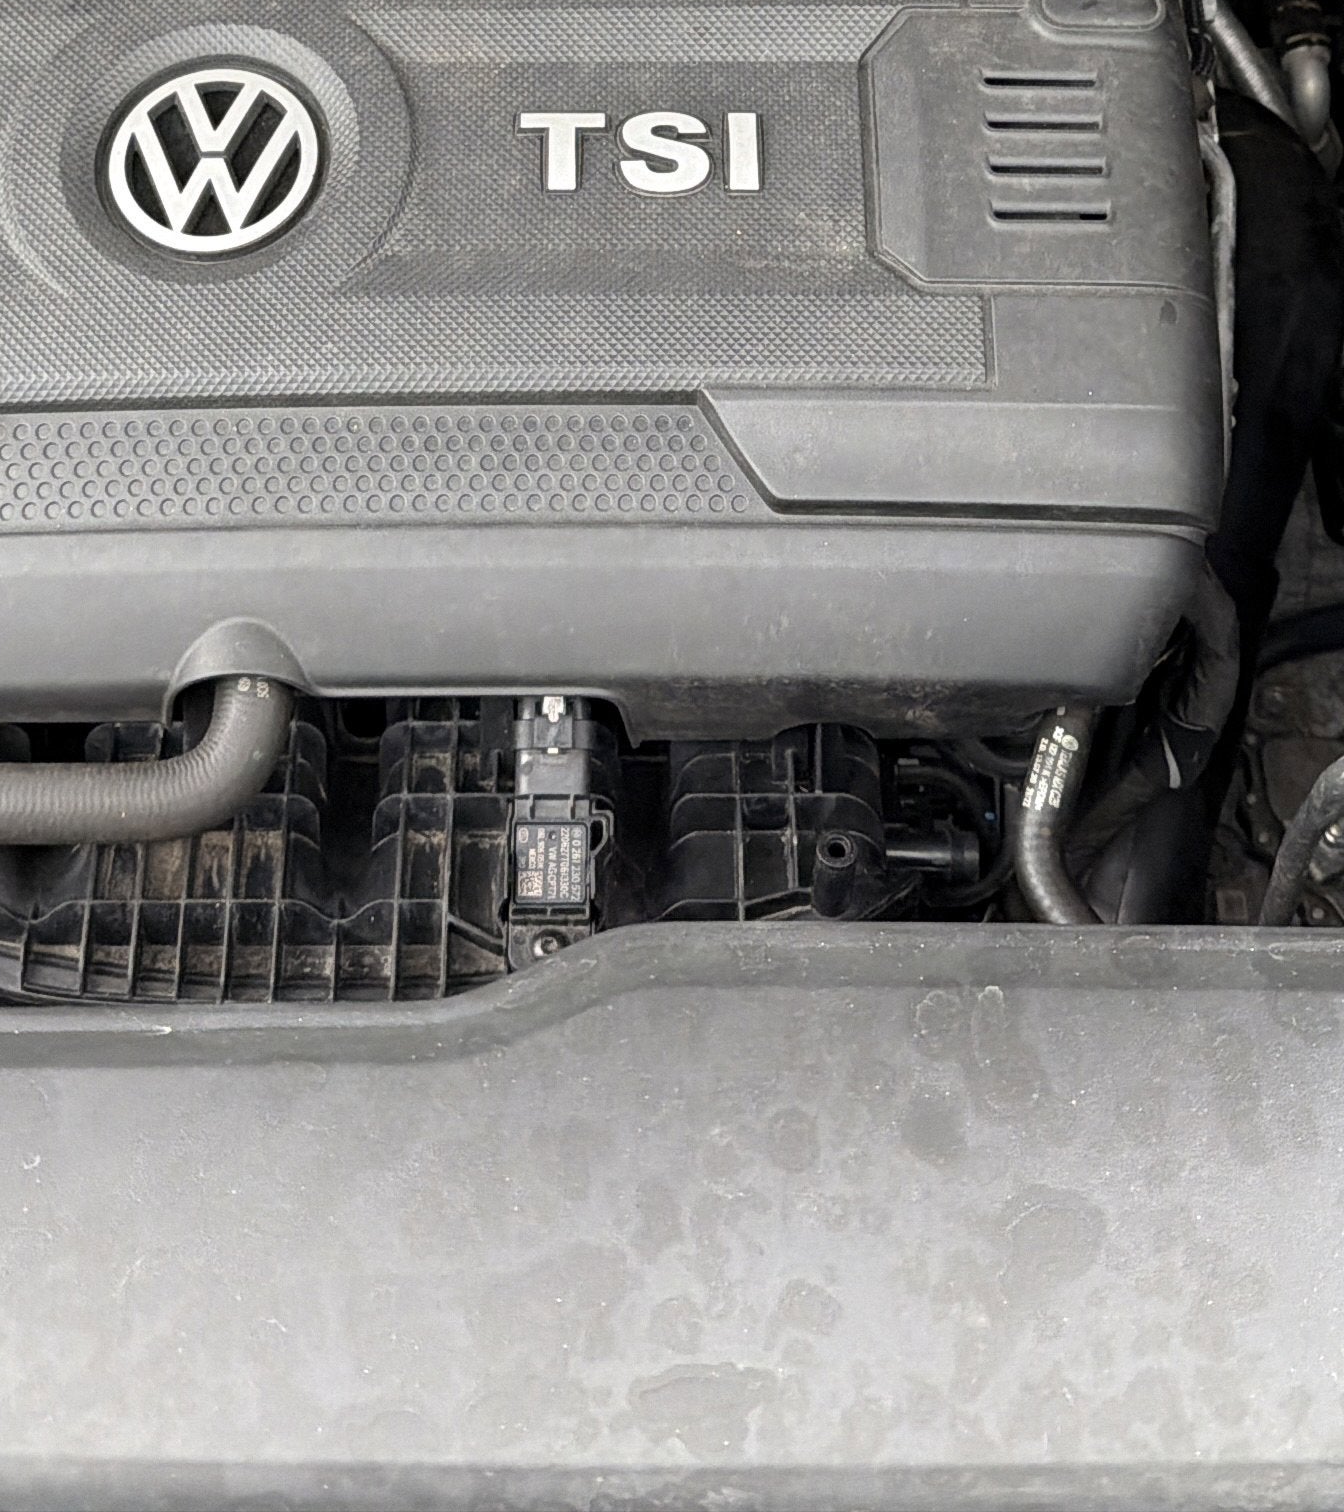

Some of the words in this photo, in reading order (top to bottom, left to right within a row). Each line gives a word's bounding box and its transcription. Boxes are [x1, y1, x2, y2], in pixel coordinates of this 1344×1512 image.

[519, 111, 762, 194] TSI
[571, 848, 581, 863] 261
[571, 866, 581, 882] 230
[571, 885, 581, 901] 572
